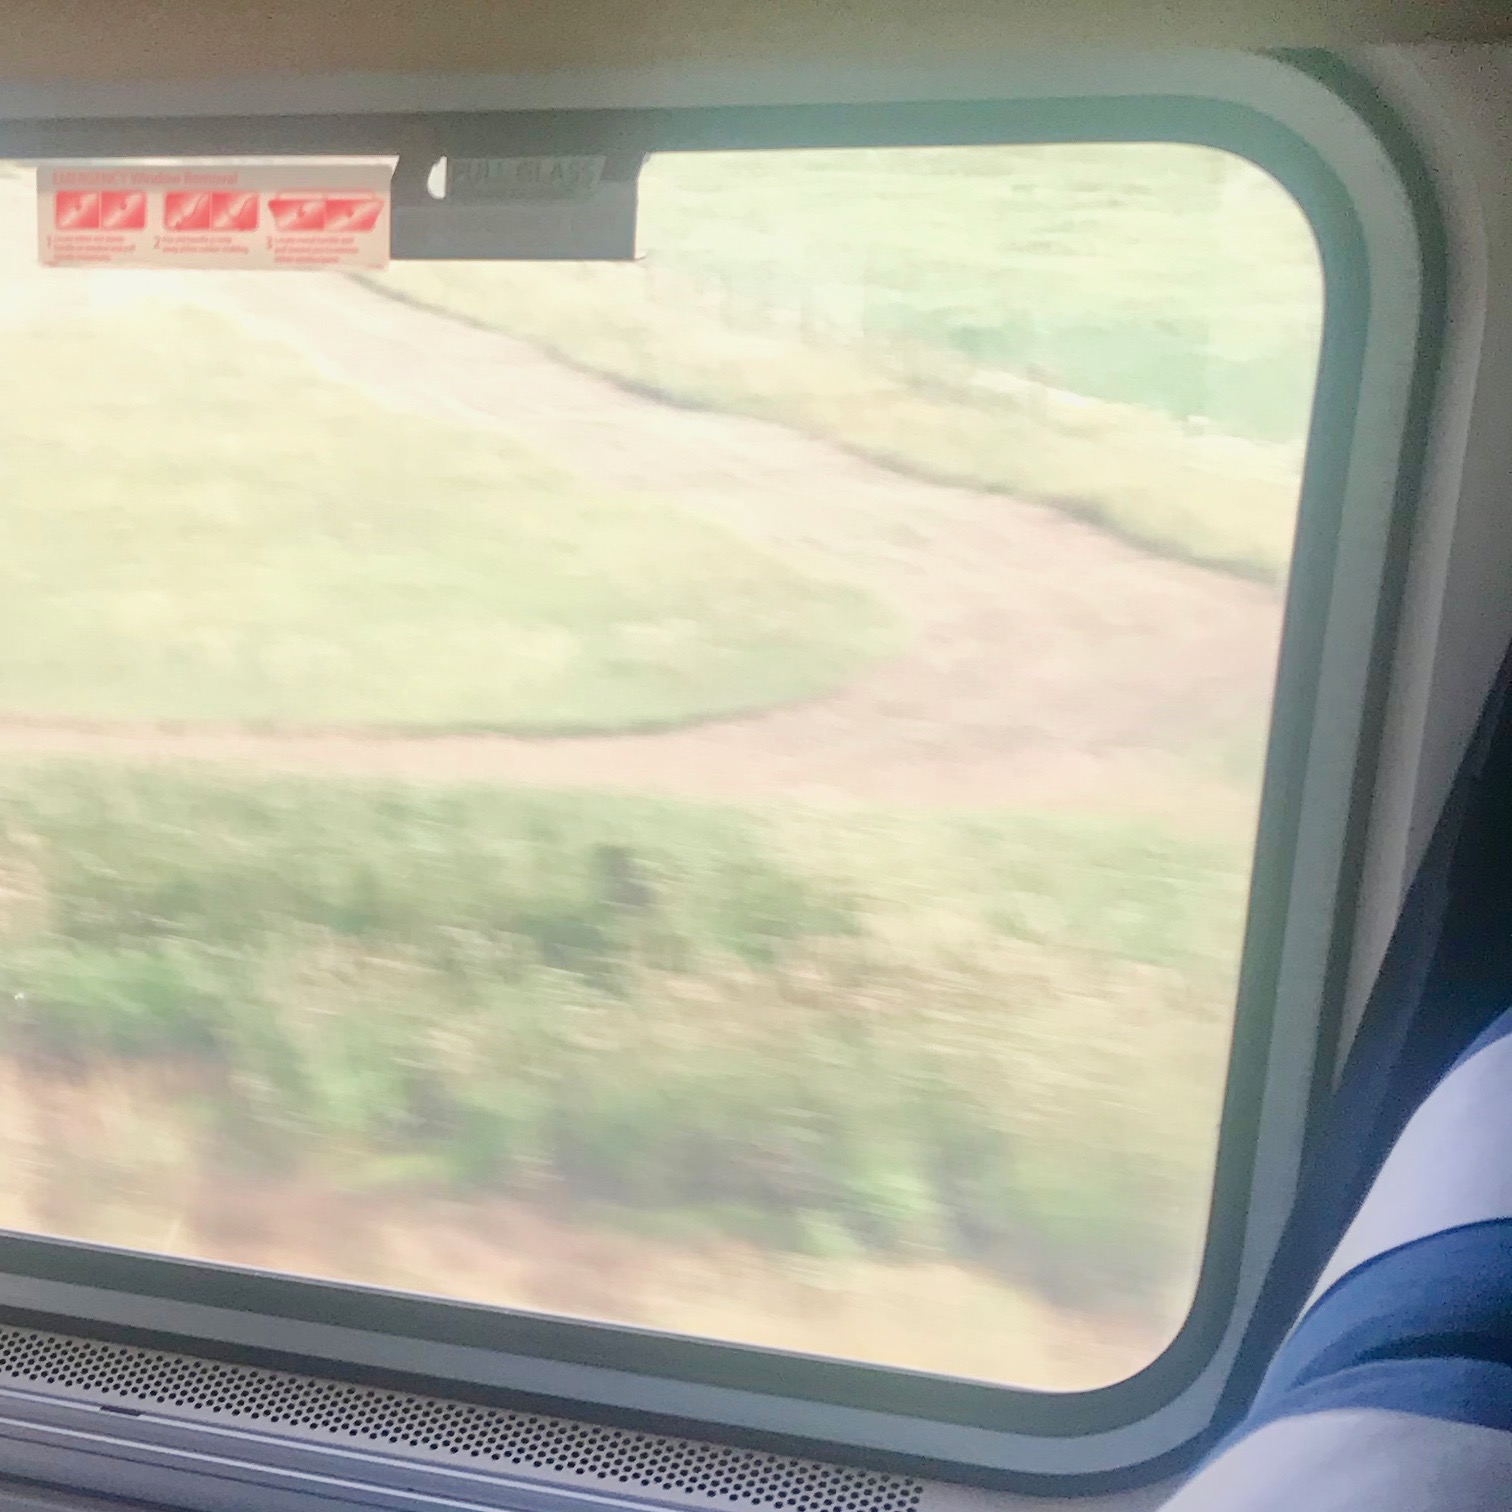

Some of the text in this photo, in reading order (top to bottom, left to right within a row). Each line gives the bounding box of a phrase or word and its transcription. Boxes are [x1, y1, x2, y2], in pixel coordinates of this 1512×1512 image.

[53, 171, 238, 186] EMERGENCY Window Removal
[515, 159, 596, 184] GLASS
[154, 235, 162, 250] 2
[266, 235, 273, 250] 3
